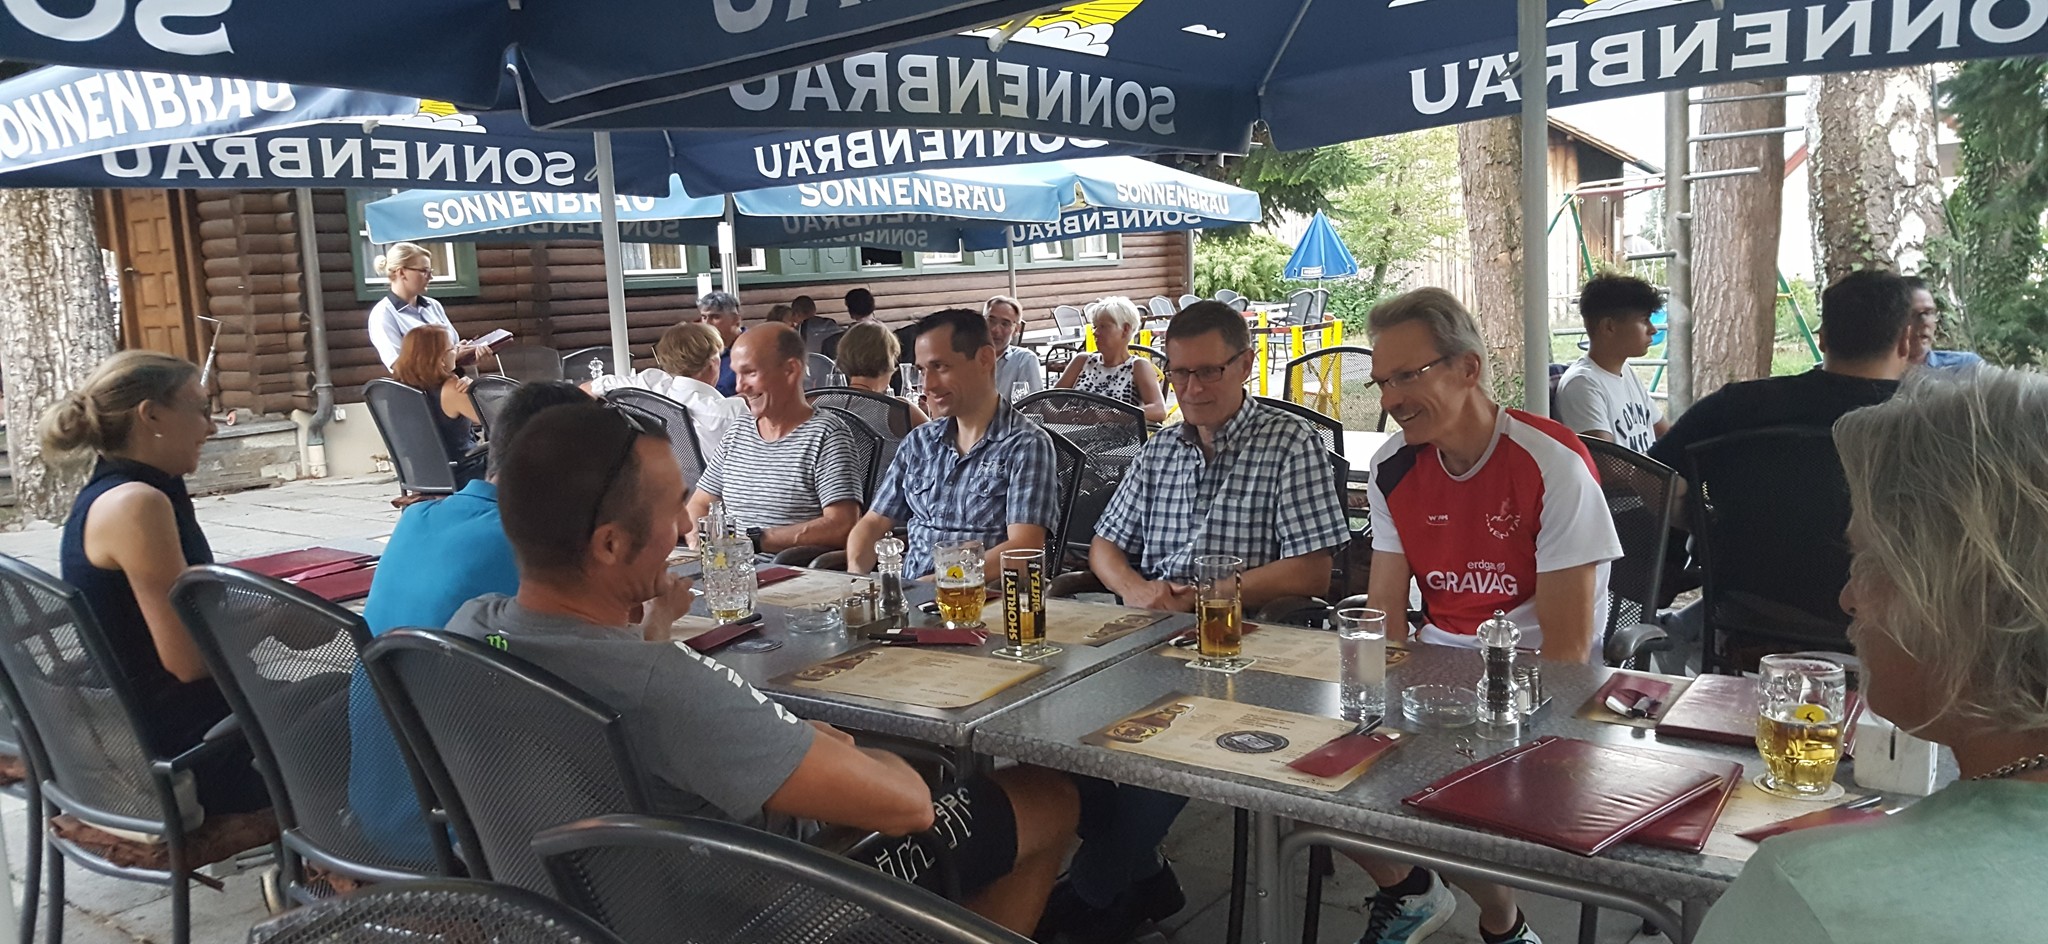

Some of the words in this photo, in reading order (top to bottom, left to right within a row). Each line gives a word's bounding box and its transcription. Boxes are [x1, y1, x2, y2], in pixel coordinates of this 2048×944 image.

[799, 177, 1006, 213] SONNENBRÄU
[1426, 570, 1519, 596] GRAVAG
[1006, 577, 1018, 640] SHORLEY
